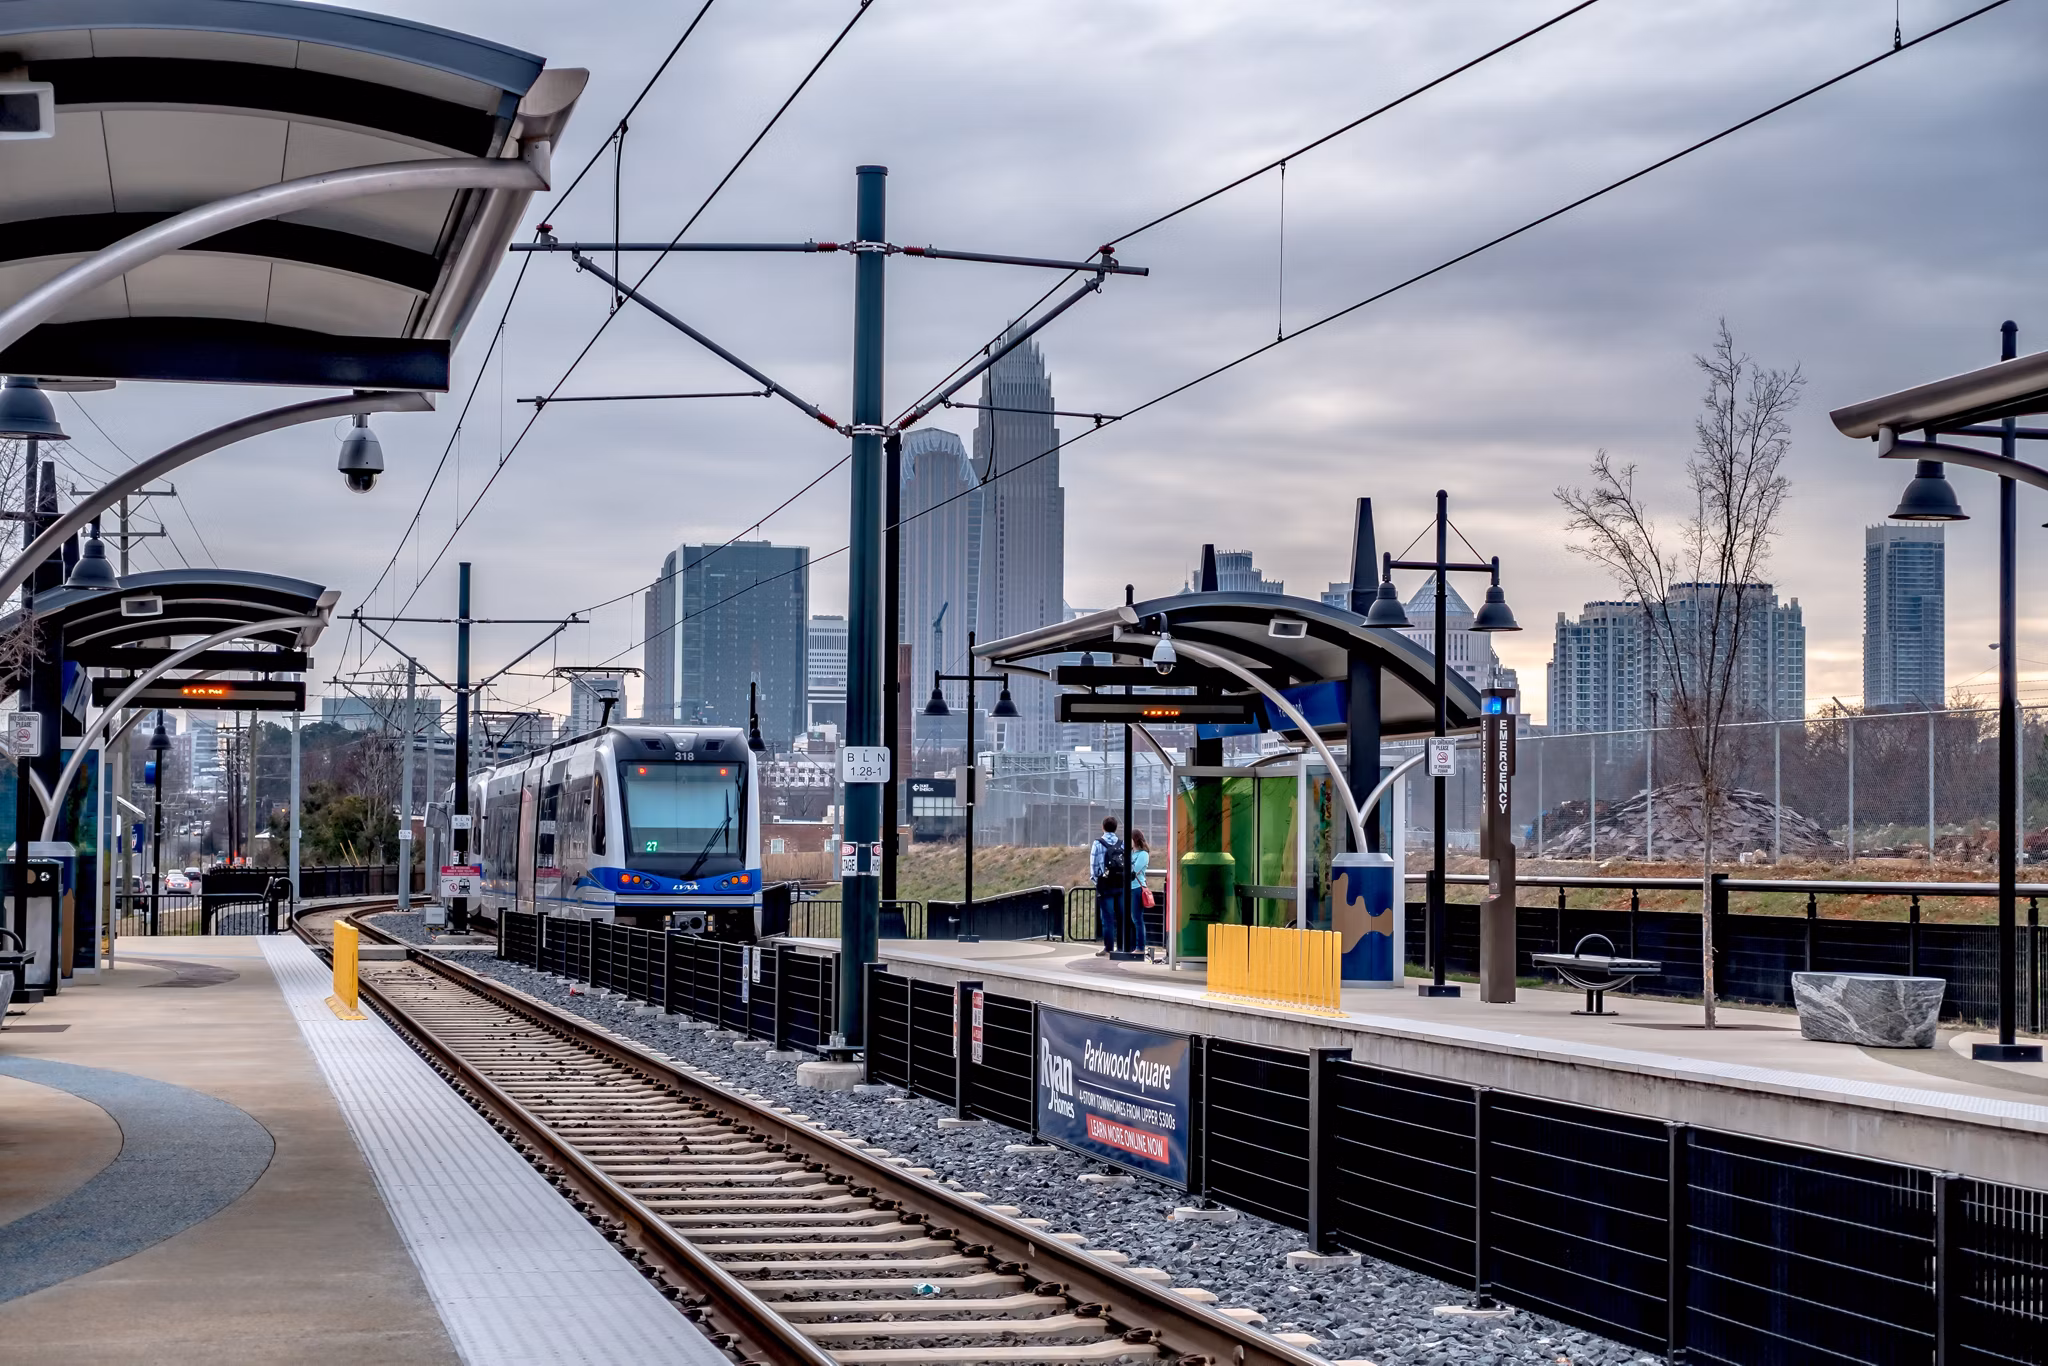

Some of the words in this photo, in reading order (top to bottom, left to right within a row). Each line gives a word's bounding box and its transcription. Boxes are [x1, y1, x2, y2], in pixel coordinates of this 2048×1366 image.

[675, 751, 694, 761] 318
[850, 766, 882, 776] 1.28-1
[1499, 720, 1508, 814] EMERGENCY
[646, 841, 657, 852] 27
[1041, 1037, 1074, 1110] Ryan
[1083, 1039, 1132, 1081] Parkwood
[1132, 1050, 1171, 1093] Square
[1054, 1092, 1075, 1118] Homes
[1080, 1090, 1096, 1107] 4-STORY
[1096, 1094, 1126, 1117] TOWNHOMES
[1126, 1104, 1141, 1120] FROM
[1141, 1107, 1159, 1126] UPPER
[1159, 1110, 1176, 1131] $300s
[1090, 1119, 1108, 1140] LEARN
[1107, 1124, 1125, 1146] MORE
[1124, 1129, 1147, 1153] ONLINE
[1147, 1136, 1164, 1158] NOW
